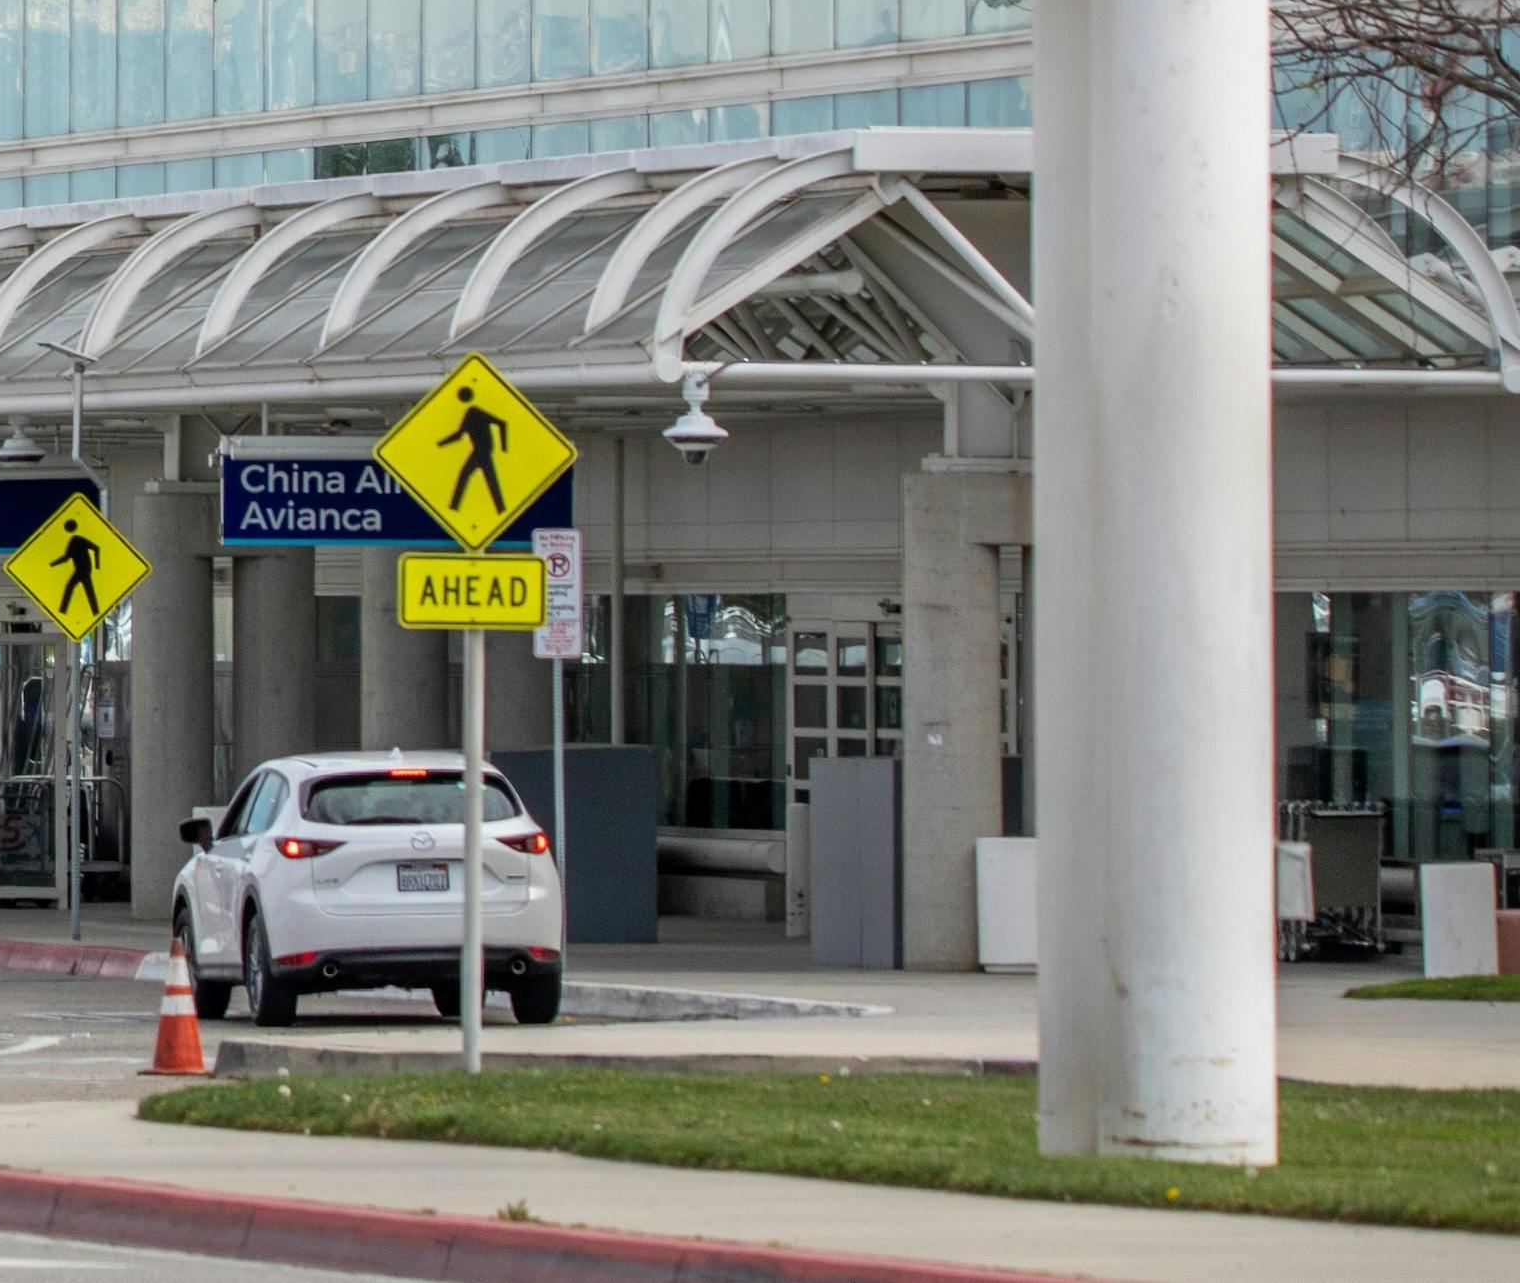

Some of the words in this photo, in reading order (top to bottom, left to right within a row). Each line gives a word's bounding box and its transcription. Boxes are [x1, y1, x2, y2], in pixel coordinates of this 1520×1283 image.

[241, 463, 345, 494] China
[240, 500, 382, 531] Avianca
[419, 575, 528, 607] AHEAD
